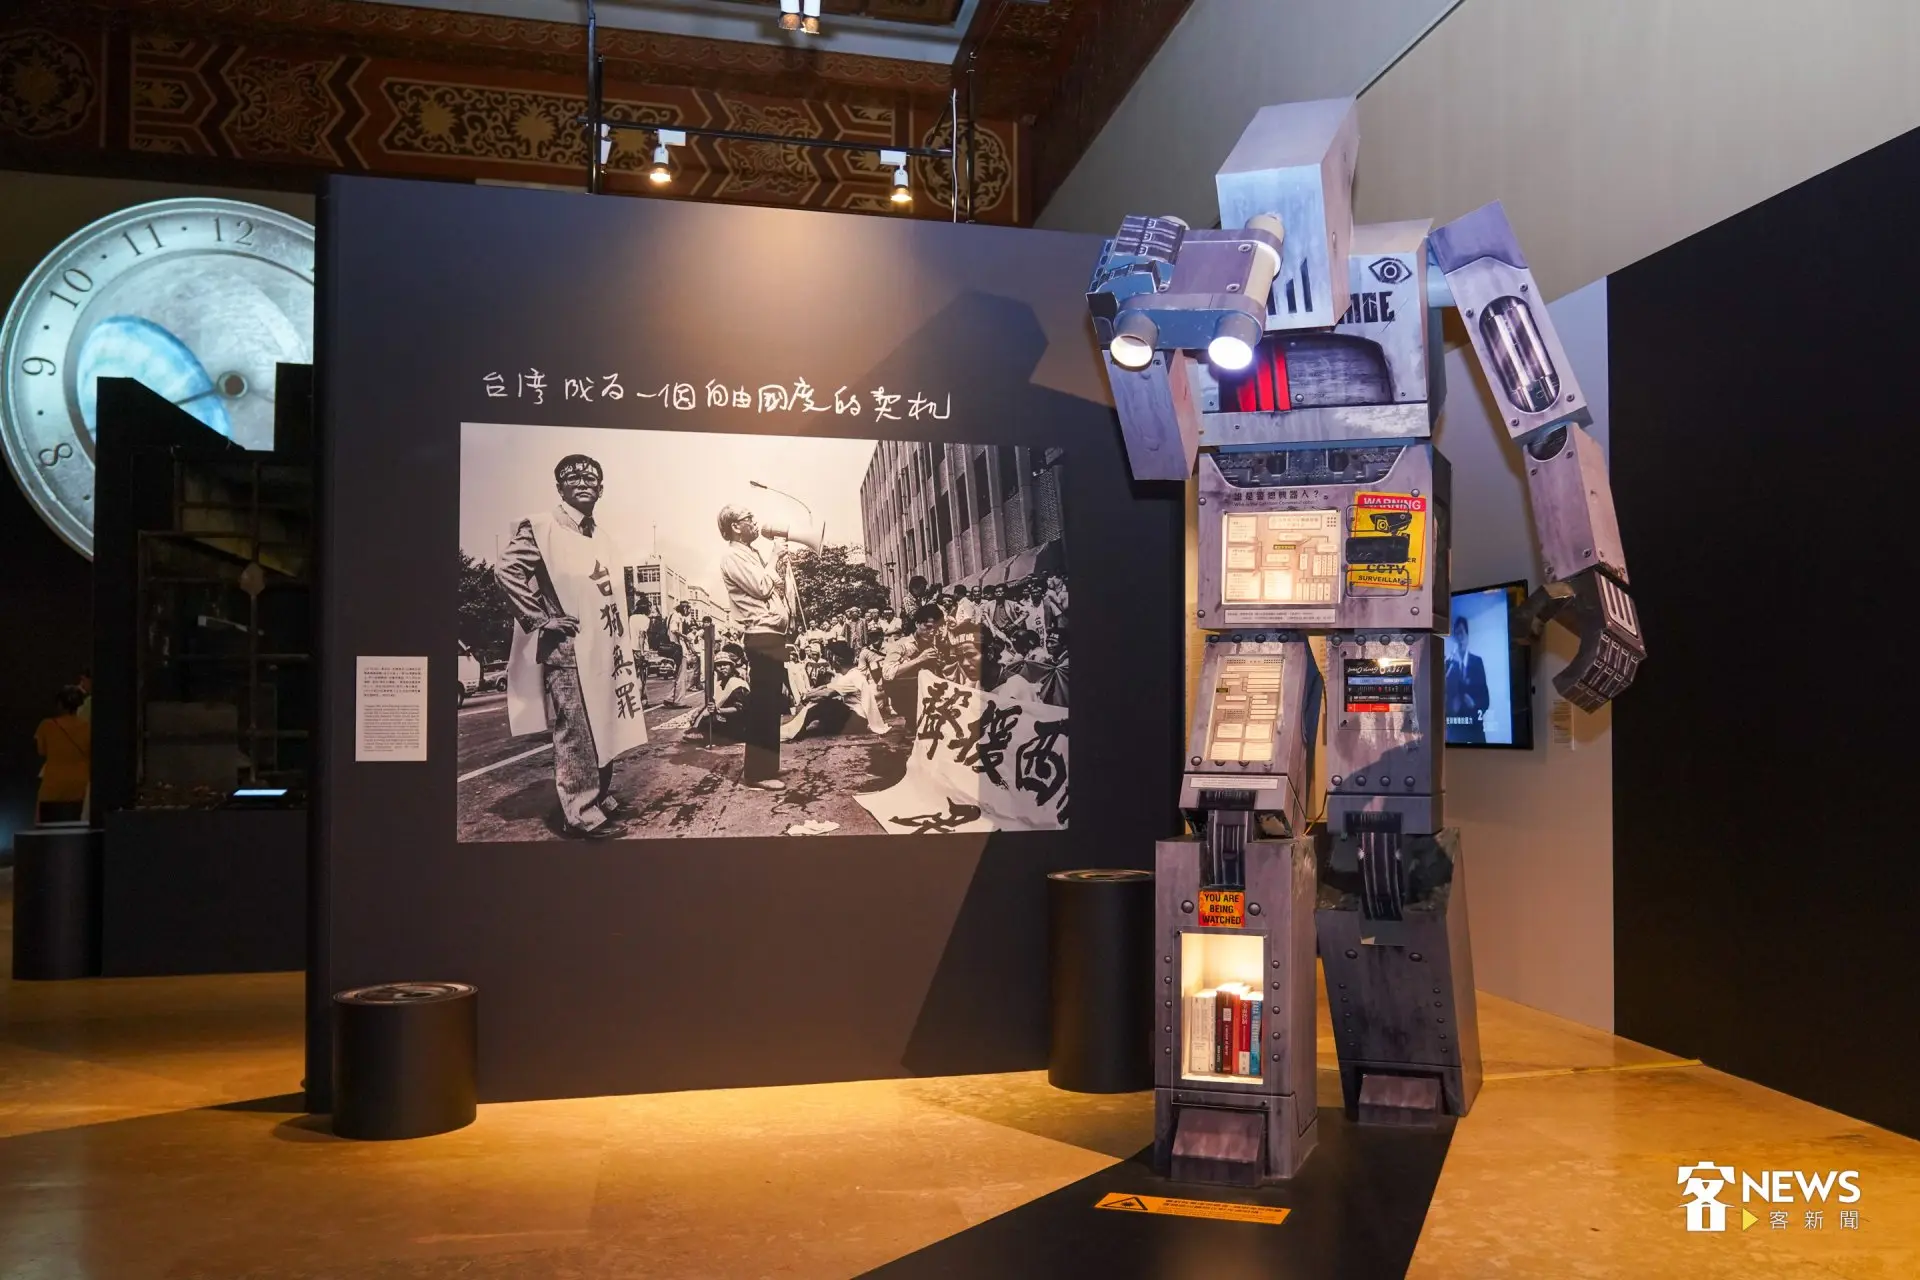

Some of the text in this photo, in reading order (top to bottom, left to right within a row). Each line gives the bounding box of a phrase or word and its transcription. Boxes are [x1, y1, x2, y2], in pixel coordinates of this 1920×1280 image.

[121, 223, 165, 257] 11
[213, 216, 254, 247] 12
[49, 267, 94, 311] 10
[22, 356, 57, 378] 9
[37, 441, 74, 468] 8
[1363, 497, 1421, 510] WARNING
[1366, 563, 1406, 575] CCTV
[1204, 893, 1240, 903] YOU ARE
[1209, 904, 1234, 914] BEING
[1202, 915, 1241, 925] WATCHED
